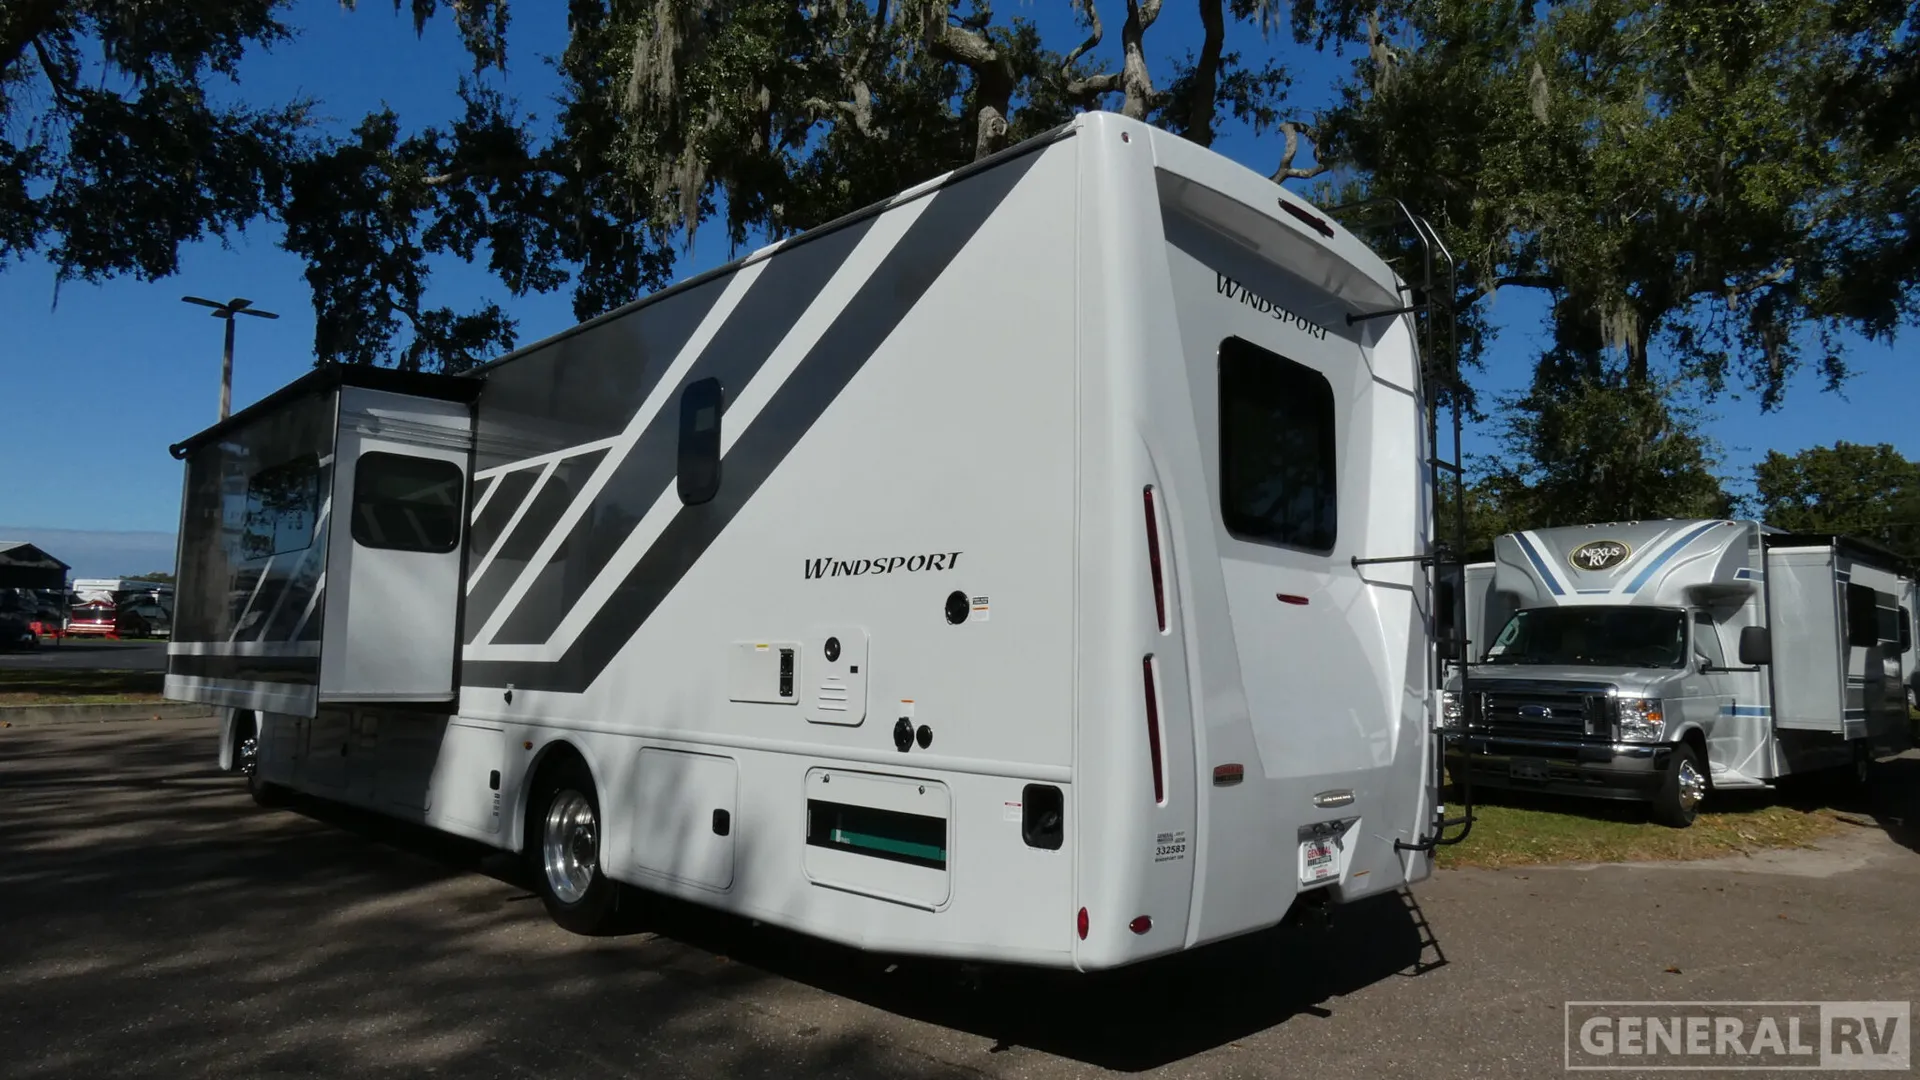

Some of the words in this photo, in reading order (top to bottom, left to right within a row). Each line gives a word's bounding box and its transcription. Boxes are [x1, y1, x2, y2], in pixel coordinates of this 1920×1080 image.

[1216, 271, 1329, 341] WINDSPORT
[1580, 546, 1620, 558] NEXUS
[804, 551, 964, 580] WINDSPORT
[1589, 555, 1609, 567] RV
[1155, 844, 1186, 856] 332583
